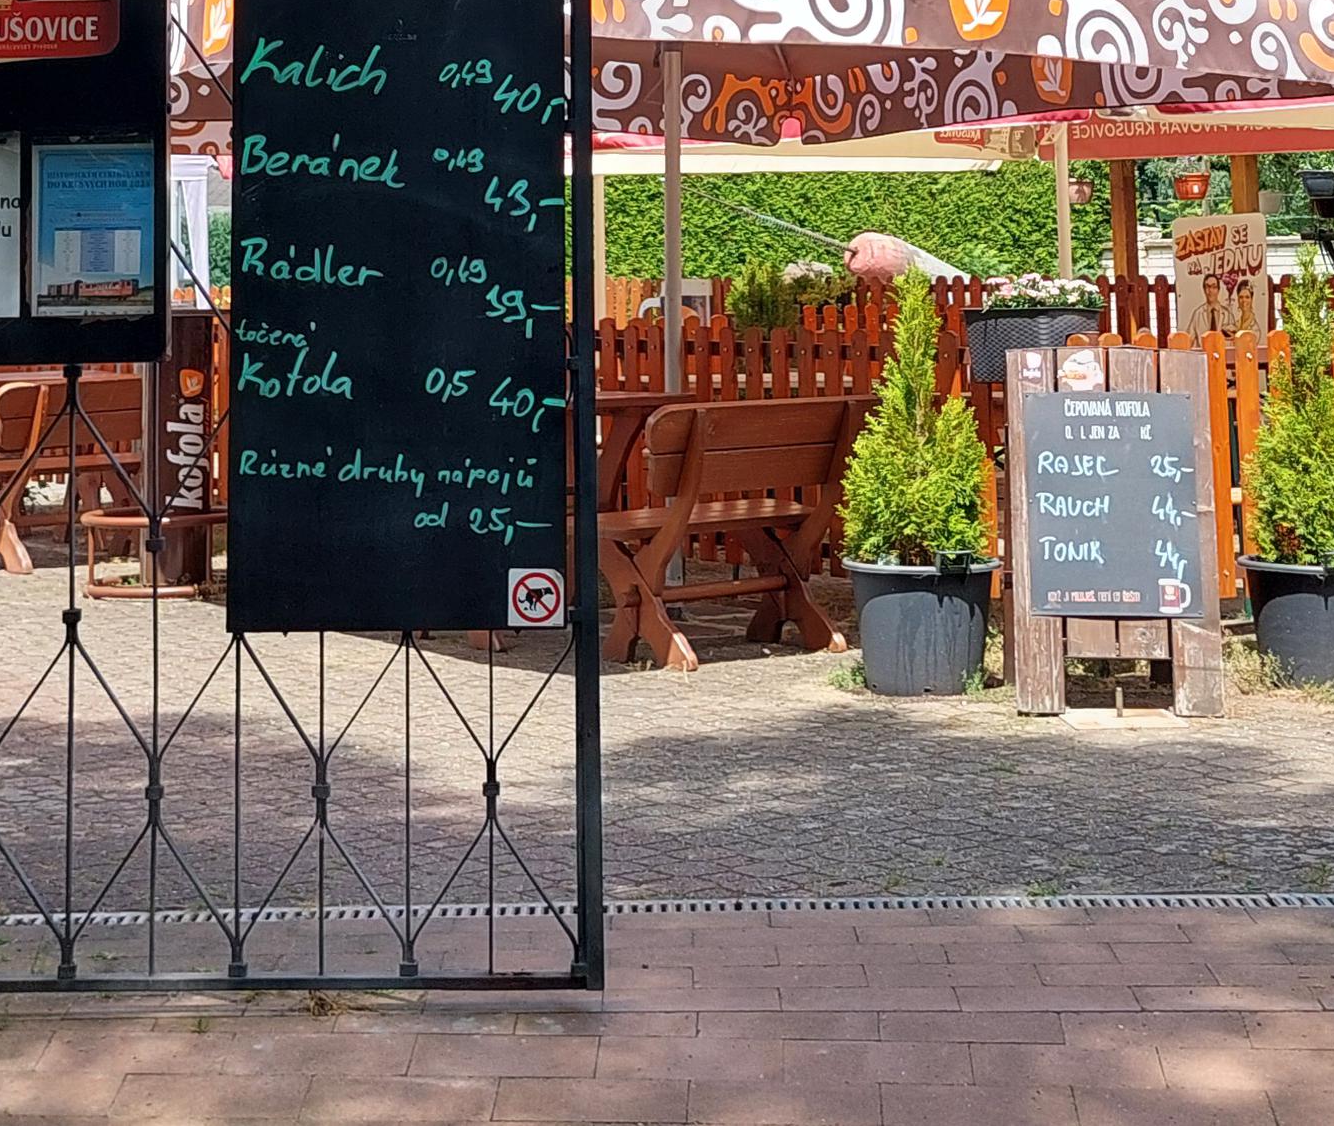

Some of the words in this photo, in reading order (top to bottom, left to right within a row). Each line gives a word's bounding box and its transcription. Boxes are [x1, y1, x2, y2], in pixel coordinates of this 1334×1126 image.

[240, 37, 387, 95] Kalich
[438, 59, 492, 88] 0,49
[241, 133, 405, 188] Beránek
[433, 148, 485, 172] 0,49
[0, 197, 21, 210] na
[1175, 224, 1227, 261] ZASTAV
[1231, 224, 1248, 246] SE
[241, 237, 383, 286] Rádler
[431, 256, 487, 286] 0,49
[1203, 244, 1263, 276] JEDNU
[425, 367, 476, 403] 0,5
[1064, 398, 1112, 417] ČEPOVANÁ
[1115, 400, 1151, 417] KOFOLA
[1108, 425, 1121, 440] ZA
[165, 403, 211, 510] kofola
[1037, 450, 1119, 477] RAJEC
[414, 501, 449, 529] od
[1034, 492, 1110, 518] RAUCH
[1039, 536, 1105, 565] TONIK
